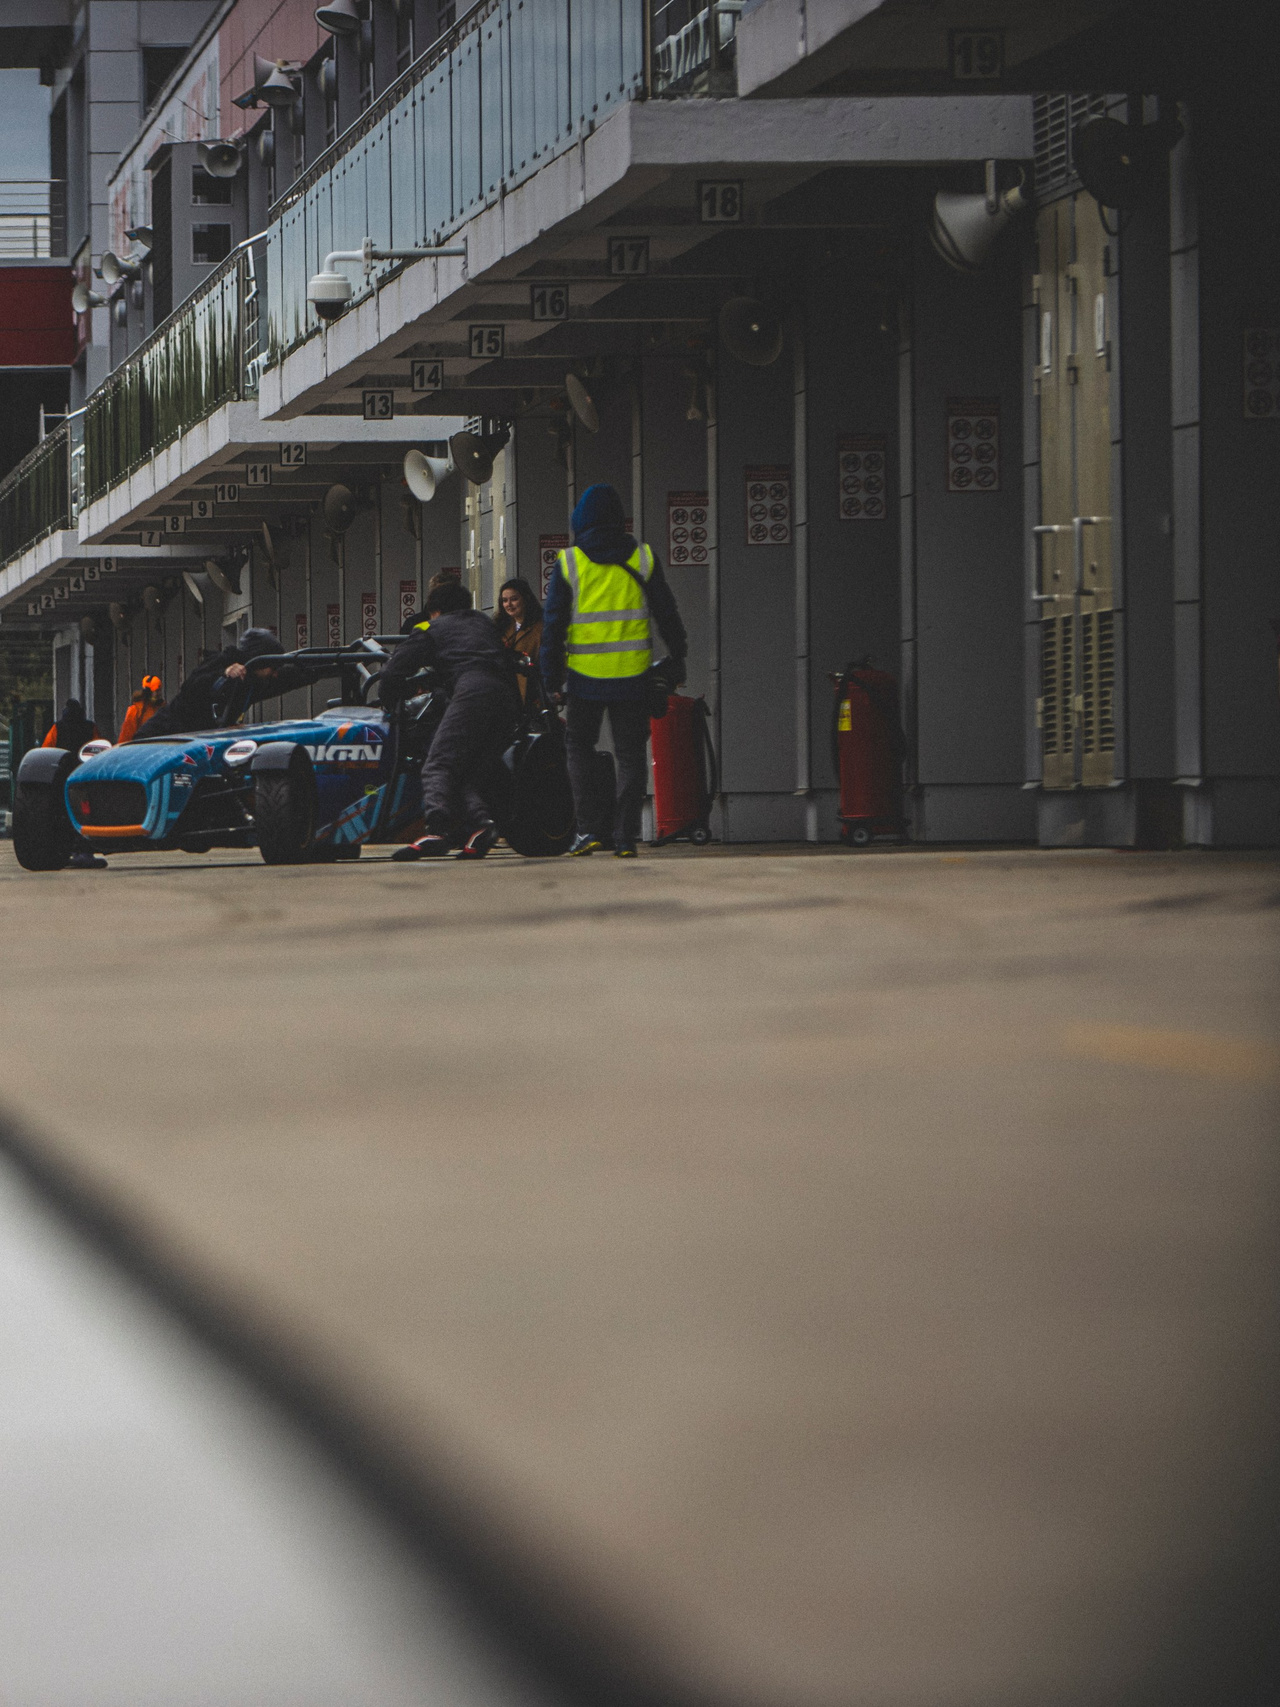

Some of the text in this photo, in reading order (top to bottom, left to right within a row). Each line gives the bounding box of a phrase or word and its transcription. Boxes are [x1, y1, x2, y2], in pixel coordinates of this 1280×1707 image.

[956, 36, 998, 74] 19
[704, 187, 738, 217] 18
[614, 243, 644, 271] 17
[535, 290, 565, 317] 16
[473, 330, 500, 354] 15
[415, 365, 440, 388] 14
[366, 395, 390, 416] 13
[283, 444, 304, 463] 12
[250, 465, 269, 483] 11
[218, 485, 237, 501] 10
[198, 501, 207, 517] 9
[171, 517, 179, 531] 8
[147, 532, 154, 544] 7
[104, 558, 113, 571] 6
[88, 567, 96, 579] 5
[58, 587, 65, 597] 3
[73, 578, 81, 590] 4
[33, 604, 38, 614] 1
[45, 596, 52, 608] 2
